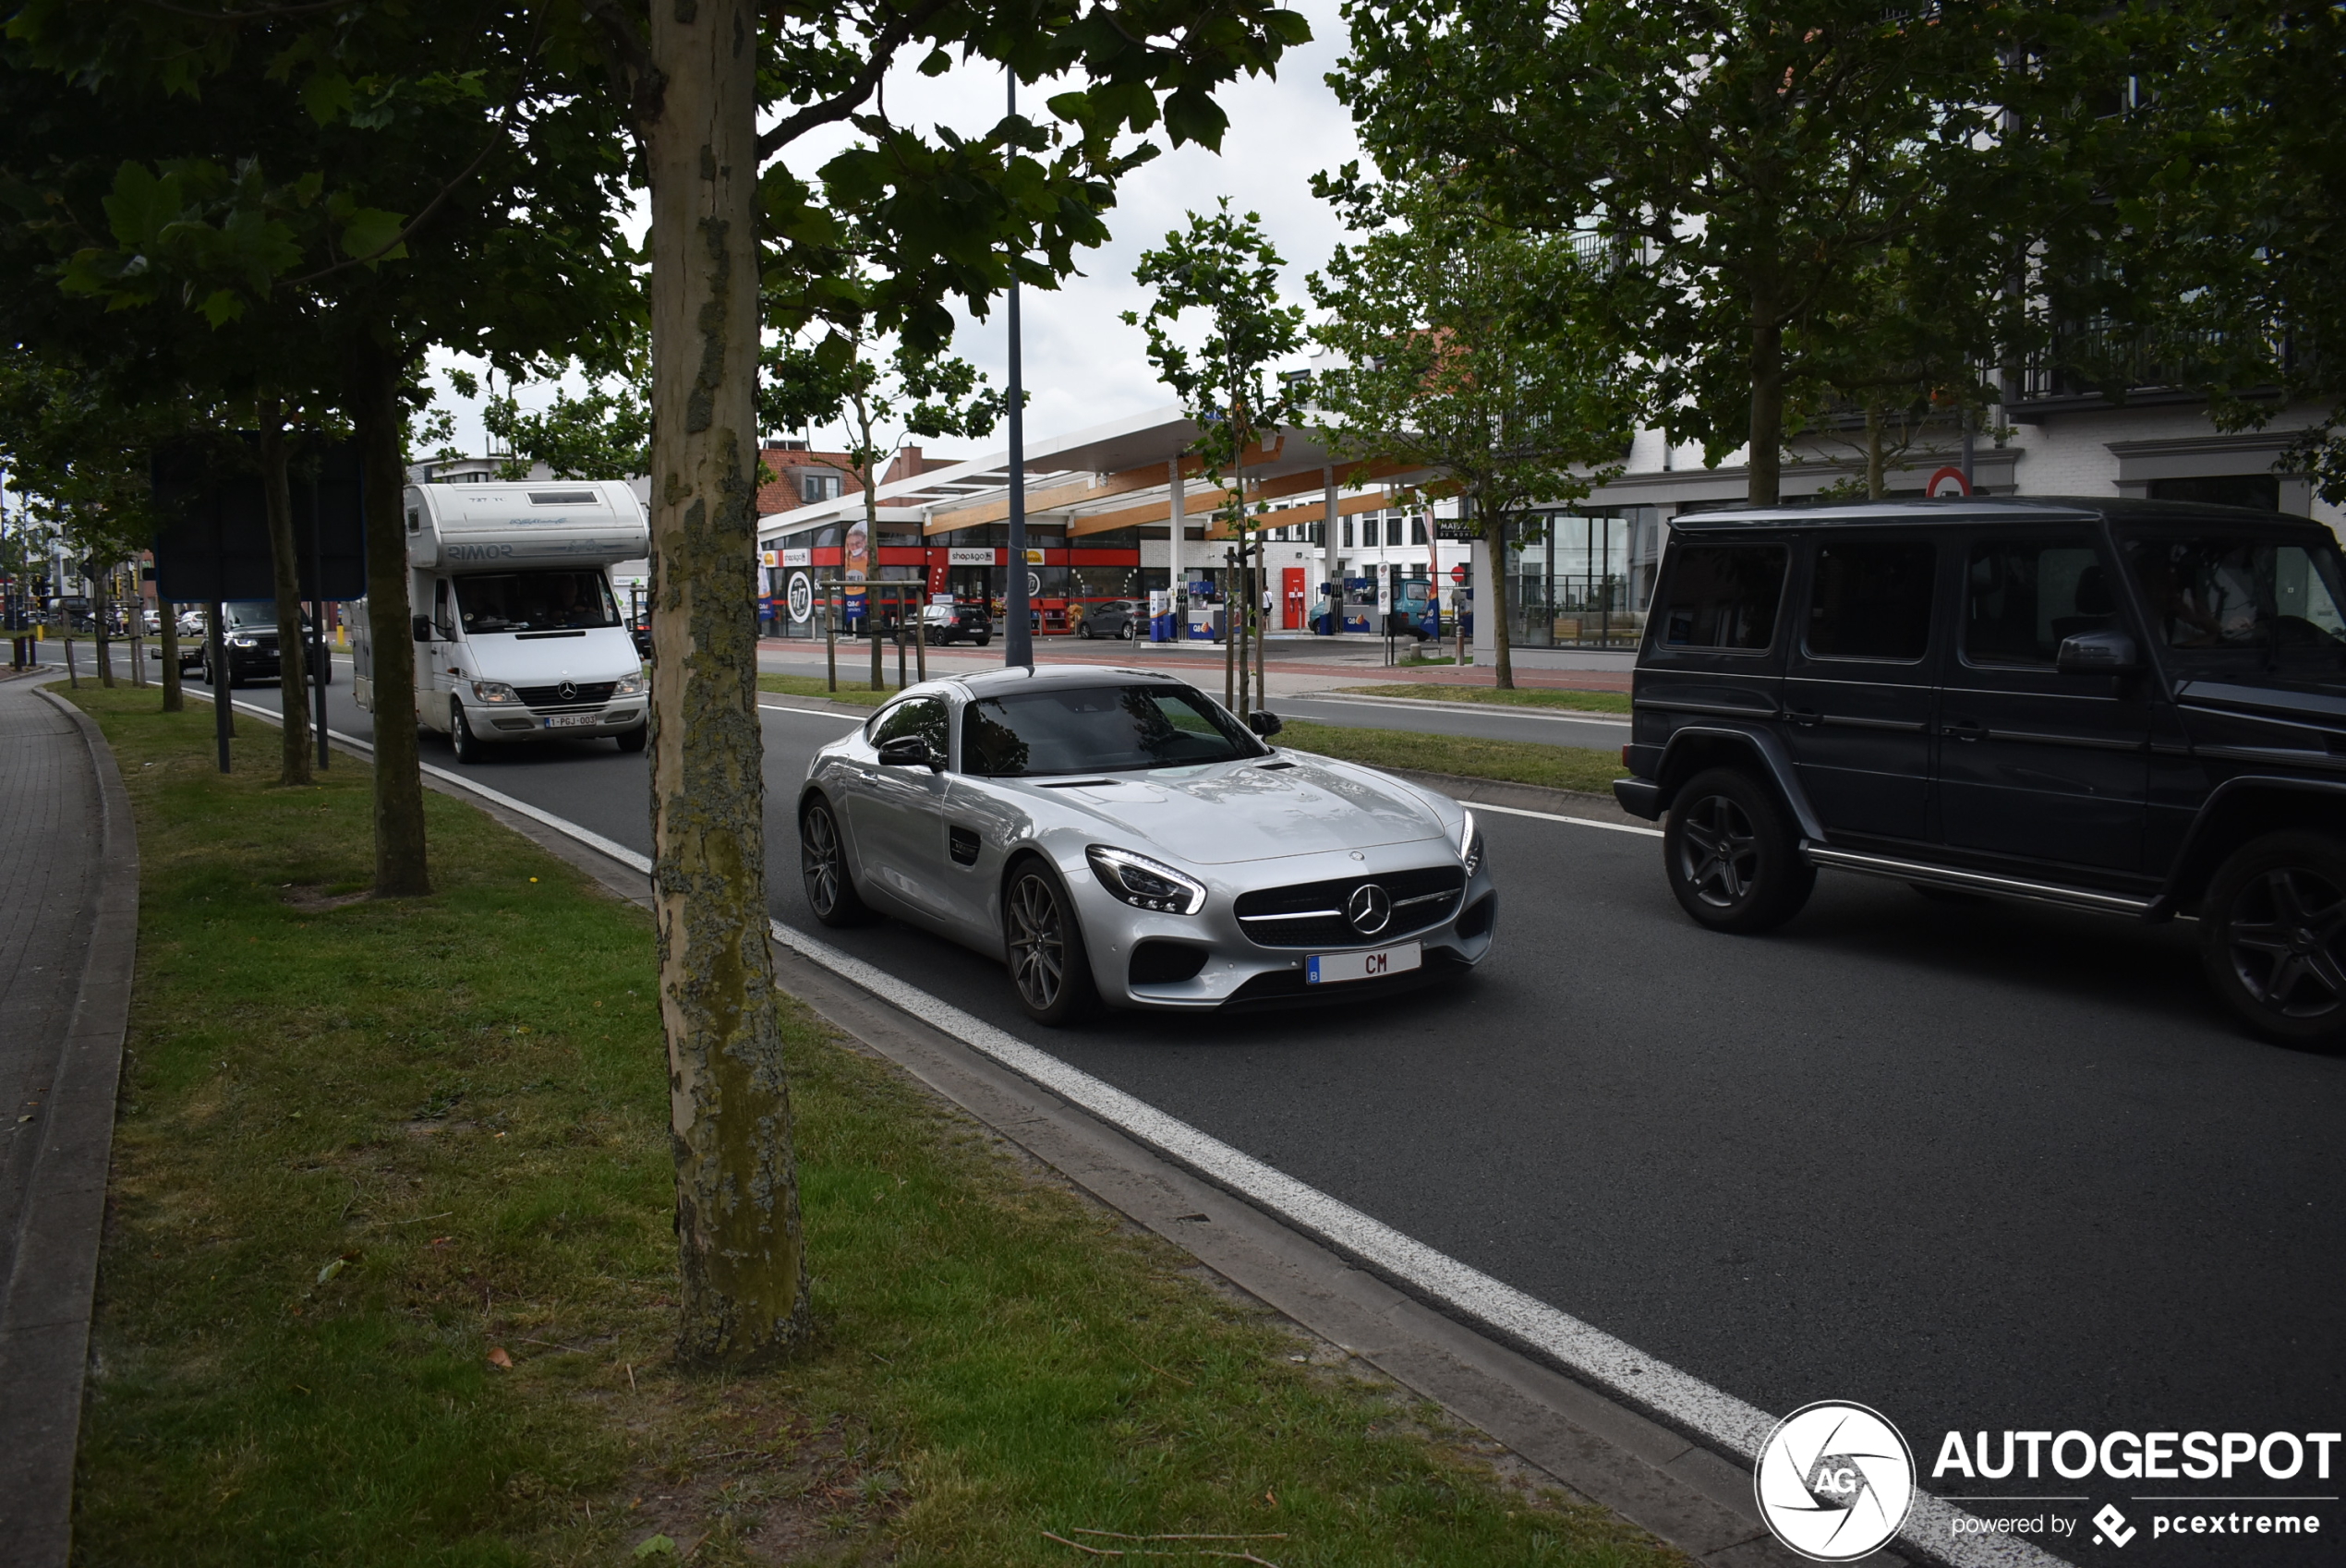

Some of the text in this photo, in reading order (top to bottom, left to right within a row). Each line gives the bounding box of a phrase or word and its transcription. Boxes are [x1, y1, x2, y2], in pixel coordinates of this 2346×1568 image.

[448, 543, 514, 561] RIMOR
[952, 552, 985, 561] shop&go
[1347, 617, 1356, 625] Q8
[1192, 624, 1201, 633] Q8
[550, 716, 595, 726] 1-PGJ-003
[1311, 953, 1387, 982] B CM
